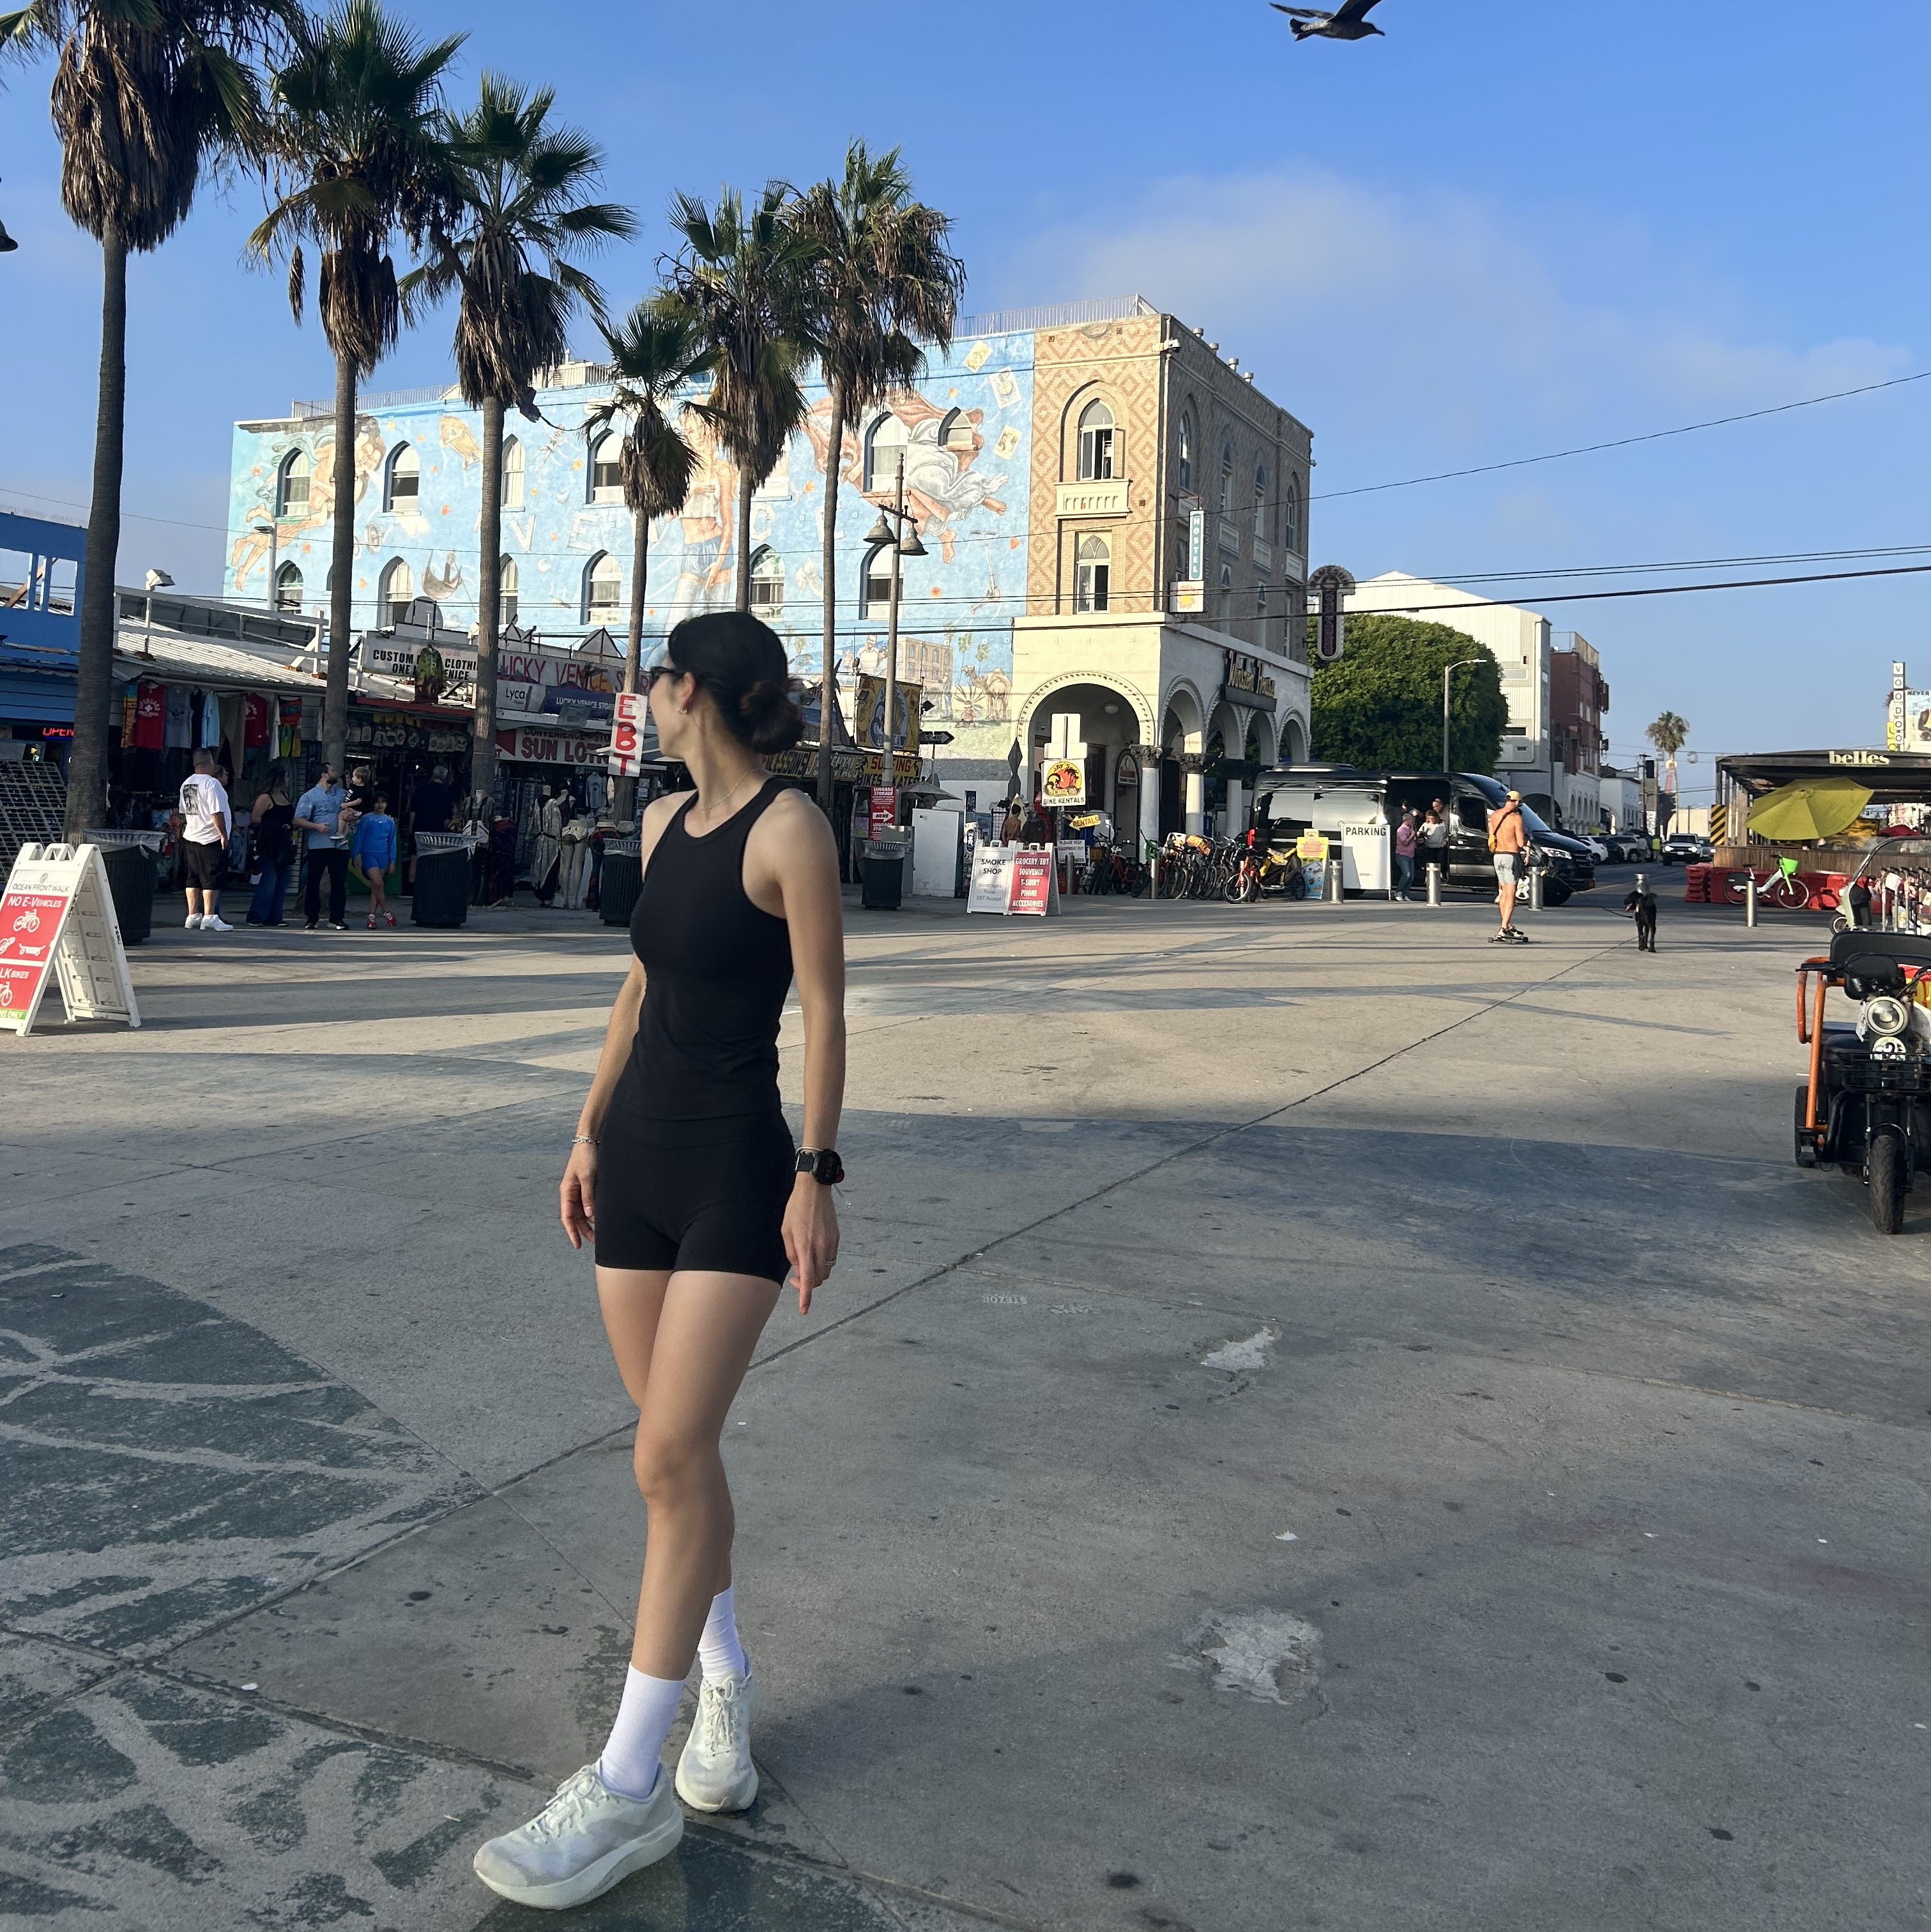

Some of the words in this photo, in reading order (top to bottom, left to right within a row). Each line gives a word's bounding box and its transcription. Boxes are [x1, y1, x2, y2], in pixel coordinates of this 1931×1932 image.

[373, 649, 413, 664] CUSTOM
[445, 658, 478, 671] CLOTHI
[392, 663, 411, 675] ONE
[443, 669, 469, 680] ENICE
[506, 687, 525, 700] Lyca
[616, 694, 638, 776] EBT
[521, 737, 558, 761] SUN
[871, 756, 912, 772] SUING
[1828, 750, 1890, 765] belles
[1053, 762, 1071, 772] JAY'S
[1072, 816, 1100, 827] RENTALS
[1345, 827, 1386, 836] PARKING
[8, 896, 22, 906] NO
[22, 897, 63, 908] E-VEHICLES
[0, 967, 12, 979] LK
[11, 970, 29, 979] BIKES
